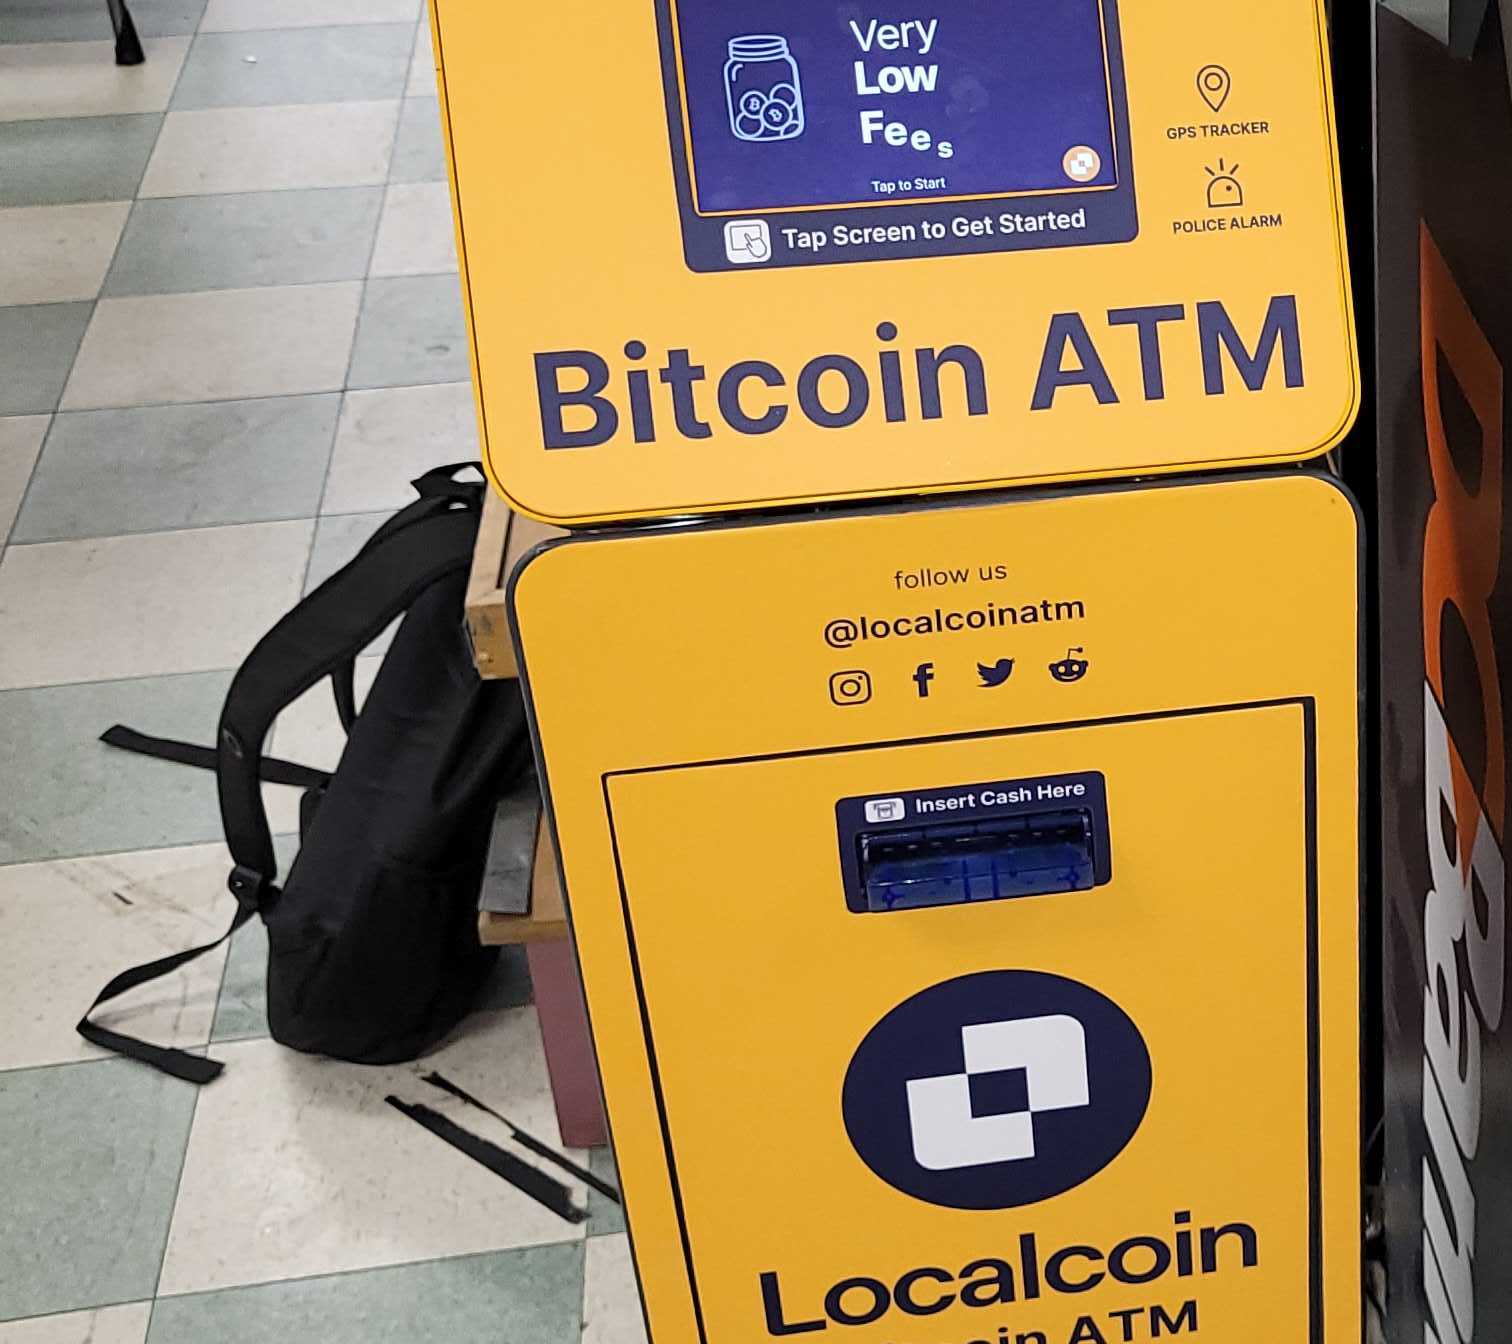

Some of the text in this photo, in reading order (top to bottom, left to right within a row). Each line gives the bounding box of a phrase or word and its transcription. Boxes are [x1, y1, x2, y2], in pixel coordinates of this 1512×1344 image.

[849, 18, 938, 54] Very
[853, 60, 938, 96] Low
[859, 109, 954, 159] Fees
[1166, 121, 1270, 140] GPS TRACKER
[871, 176, 946, 194] Tap to Start
[782, 208, 1087, 252] Tap Screen to Get Started
[1173, 213, 1283, 234] POLICE ALARM
[533, 294, 1305, 450] Bitcoin ATM
[894, 564, 1008, 590] follow us
[824, 599, 1085, 649] @localcoinatm
[915, 783, 1086, 814] Insert Cash Here
[759, 1209, 1259, 1337] Localcoin
